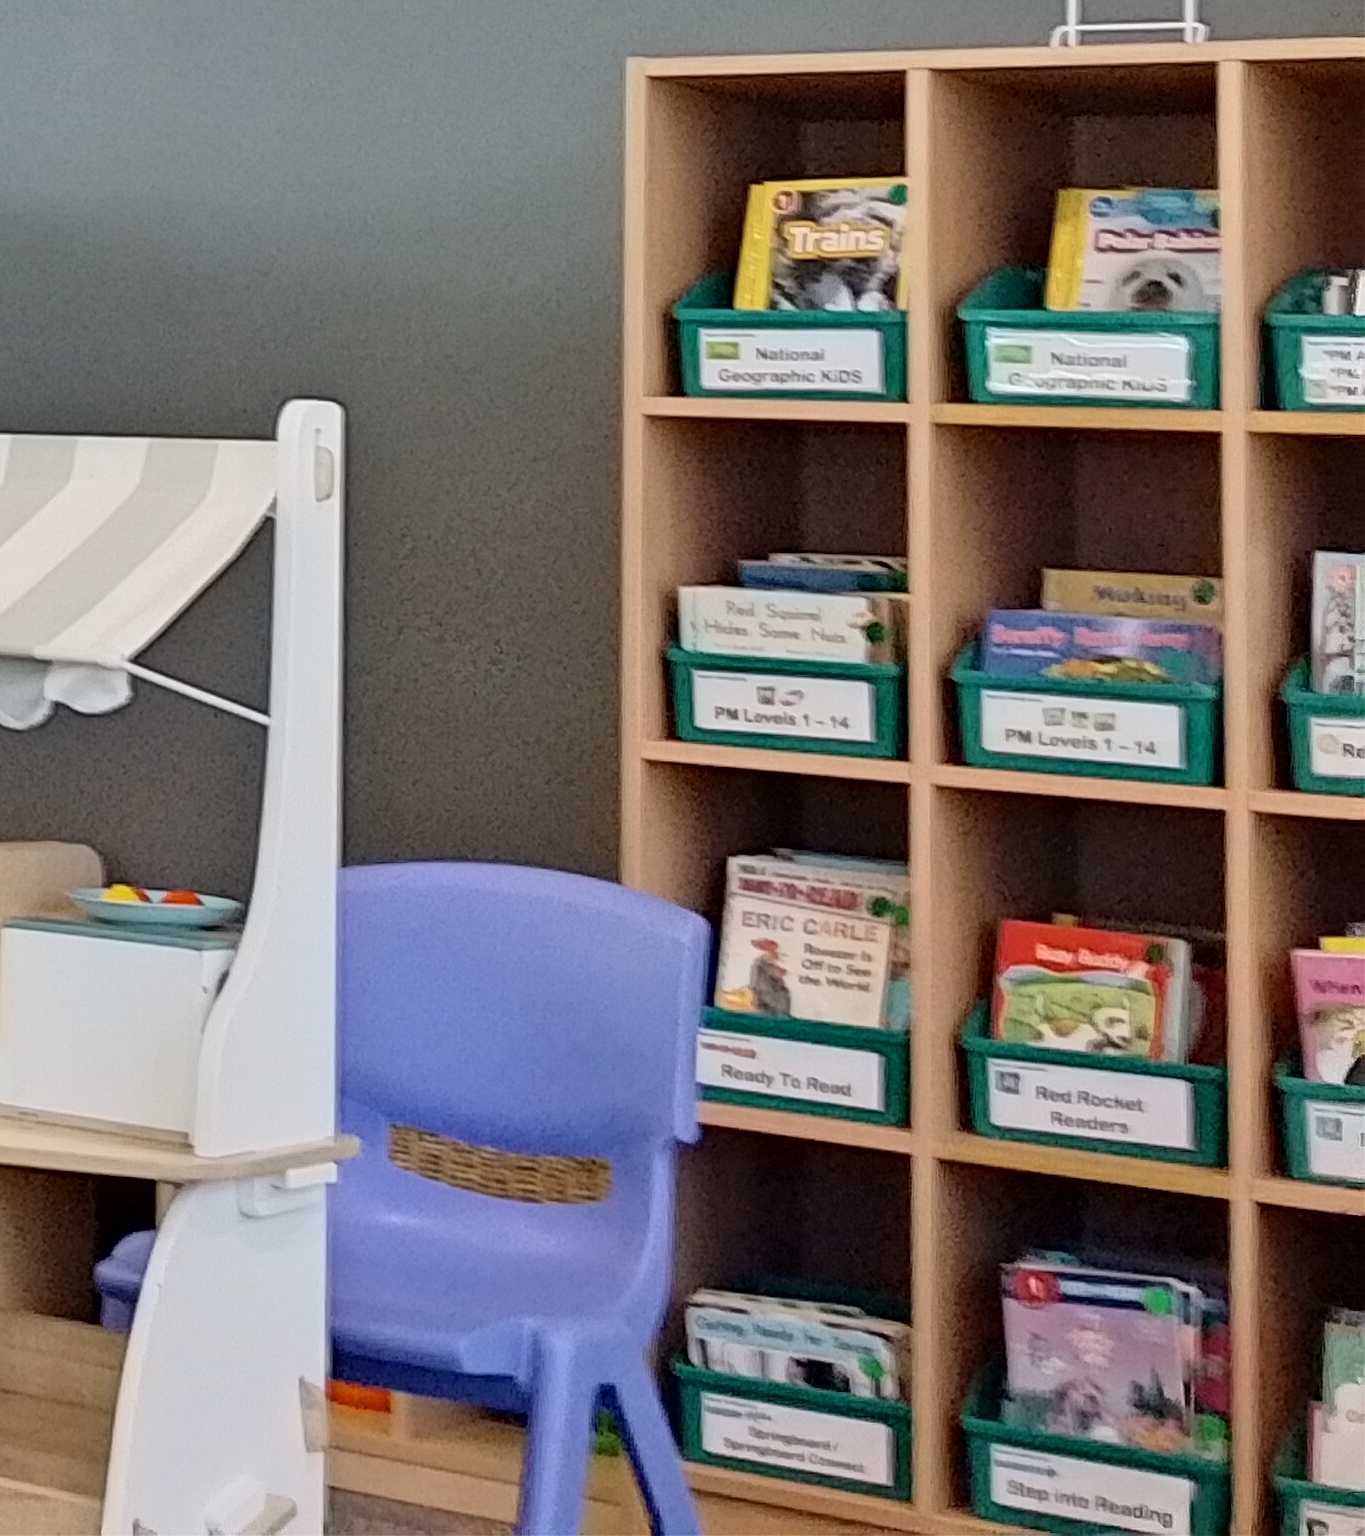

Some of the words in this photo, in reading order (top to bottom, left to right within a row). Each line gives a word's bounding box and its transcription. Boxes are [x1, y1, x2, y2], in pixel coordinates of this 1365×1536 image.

[788, 223, 885, 253] Trains
[755, 347, 826, 363] National
[1050, 351, 1128, 369] National
[718, 367, 816, 386] Geographic
[725, 601, 755, 617] Red
[758, 622, 801, 640] Some
[714, 705, 739, 721] PM
[743, 708, 797, 726] Levels
[830, 715, 850, 730] 14
[1004, 727, 1032, 744] PM
[1037, 730, 1098, 750] Levels
[1134, 740, 1158, 755] 14
[1342, 742, 1365, 759] Re
[741, 910, 795, 933] ERIC
[802, 917, 879, 943] CARLE
[720, 1063, 774, 1088] Ready
[779, 1071, 802, 1090] To
[806, 1076, 853, 1097] Read
[1035, 1084, 1072, 1104] Red
[1076, 1090, 1145, 1113] Rocket
[1049, 1111, 1130, 1135] Readers
[1006, 1479, 1050, 1504] Step
[1054, 1488, 1089, 1510] into
[1094, 1495, 1173, 1529] Reading
